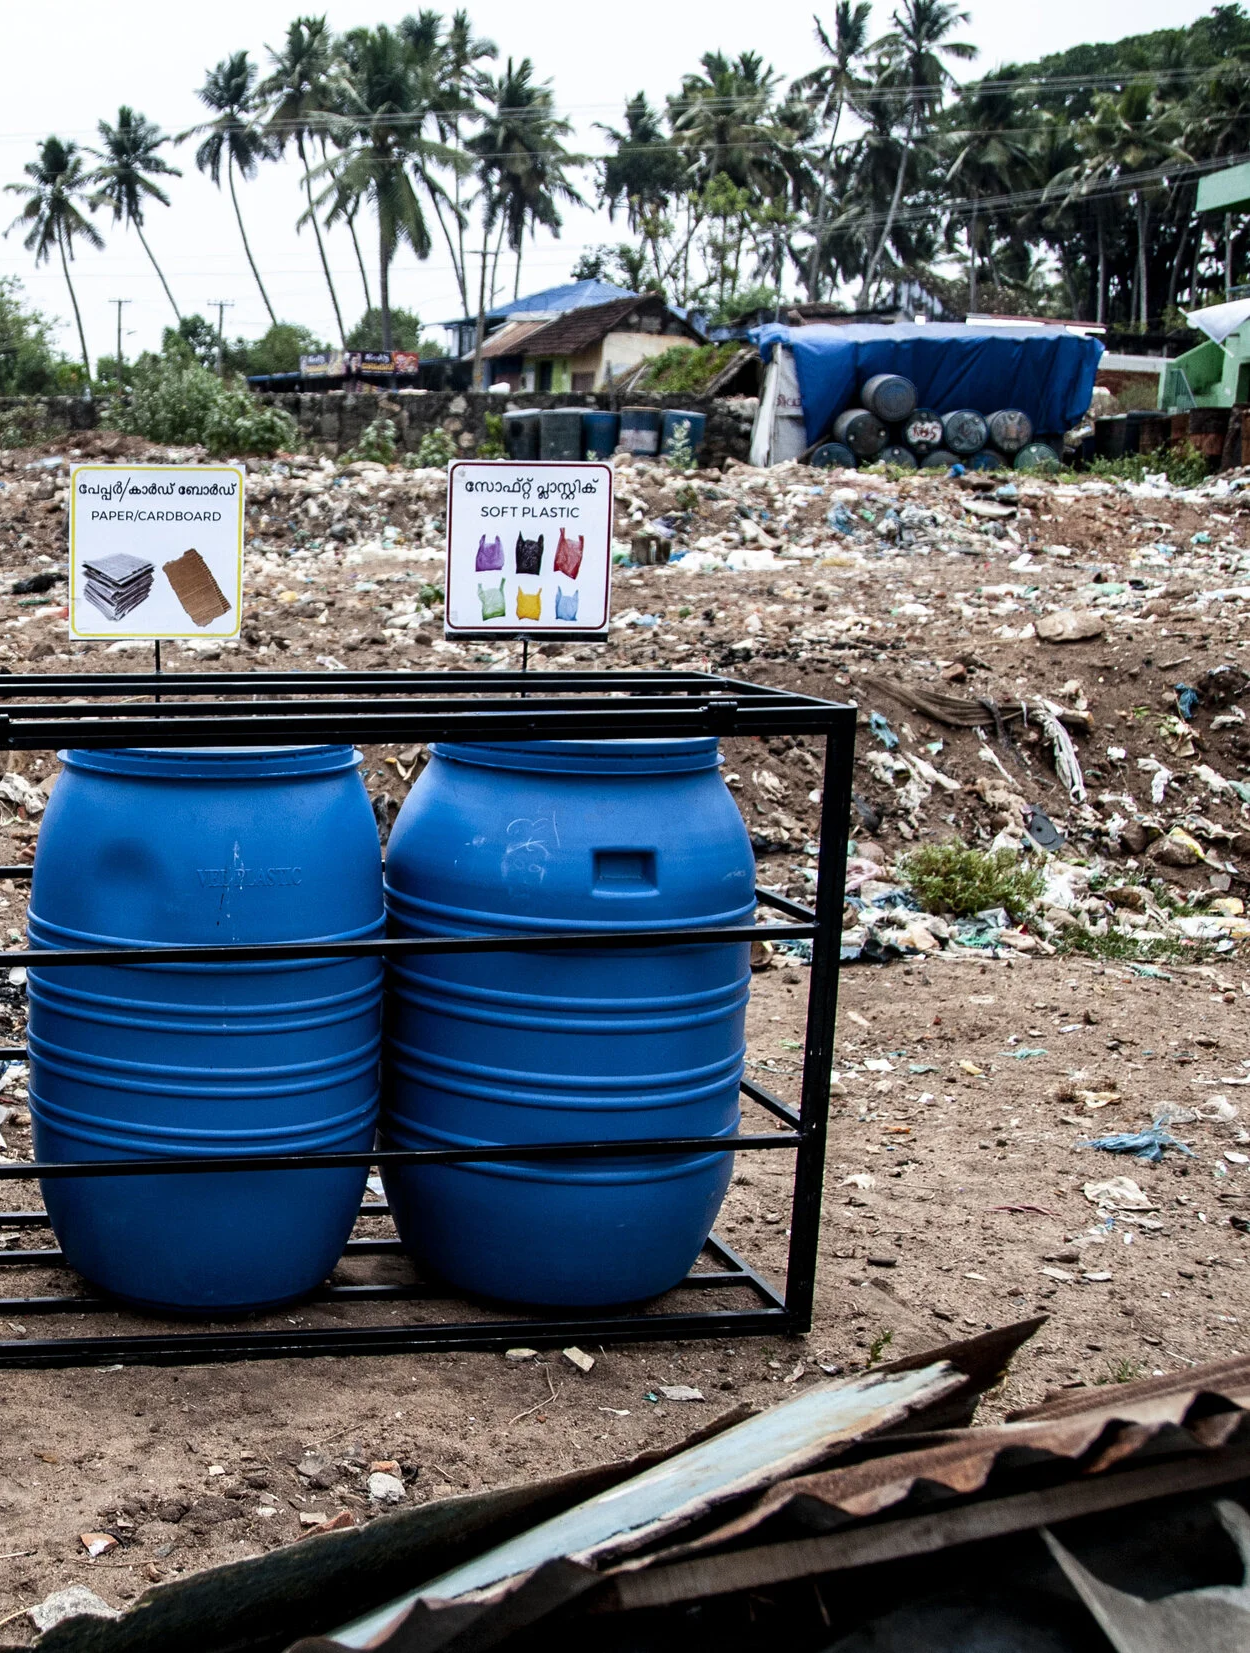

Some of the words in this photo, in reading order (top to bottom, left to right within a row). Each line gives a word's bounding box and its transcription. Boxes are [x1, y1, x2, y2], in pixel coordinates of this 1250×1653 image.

[178, 483, 237, 496] ബോർഡ്
[536, 478, 599, 500] പ്ലാസ്റ്റിക്
[91, 510, 222, 522] PAPER/CARDBOARD
[480, 506, 518, 518] SOFT
[522, 506, 580, 518] PLASTIC
[234, 867, 302, 887] PLASTIC
